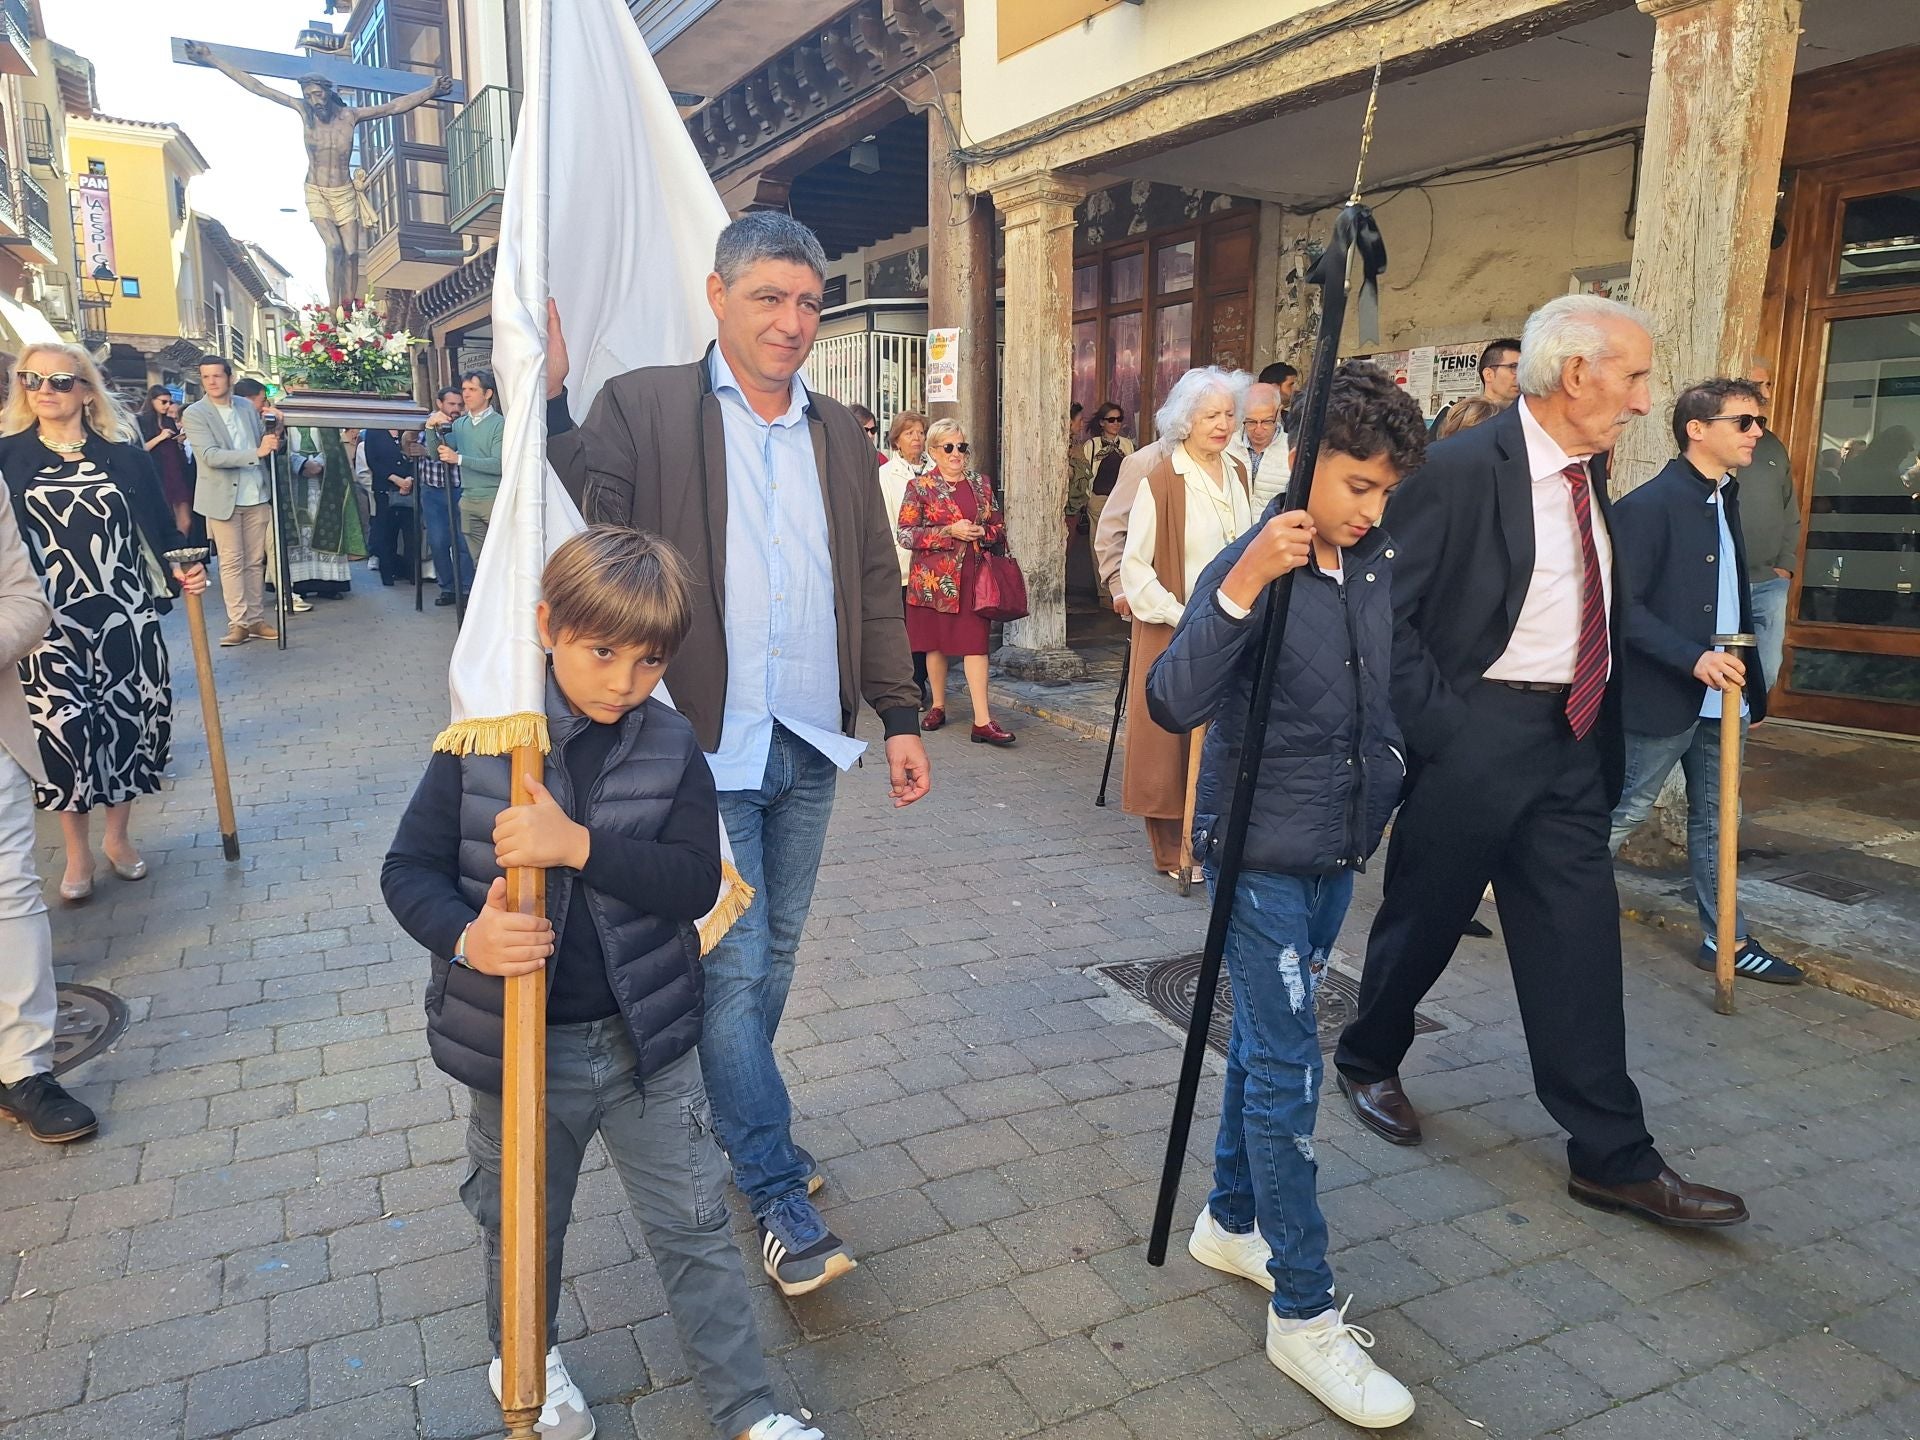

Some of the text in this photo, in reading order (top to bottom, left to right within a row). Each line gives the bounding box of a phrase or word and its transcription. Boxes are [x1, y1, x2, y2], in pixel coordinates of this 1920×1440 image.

[79, 176, 108, 190] PAN
[86, 195, 105, 211] LA
[90, 213, 108, 266] ESPIG
[1441, 354, 1477, 370] TENIS
